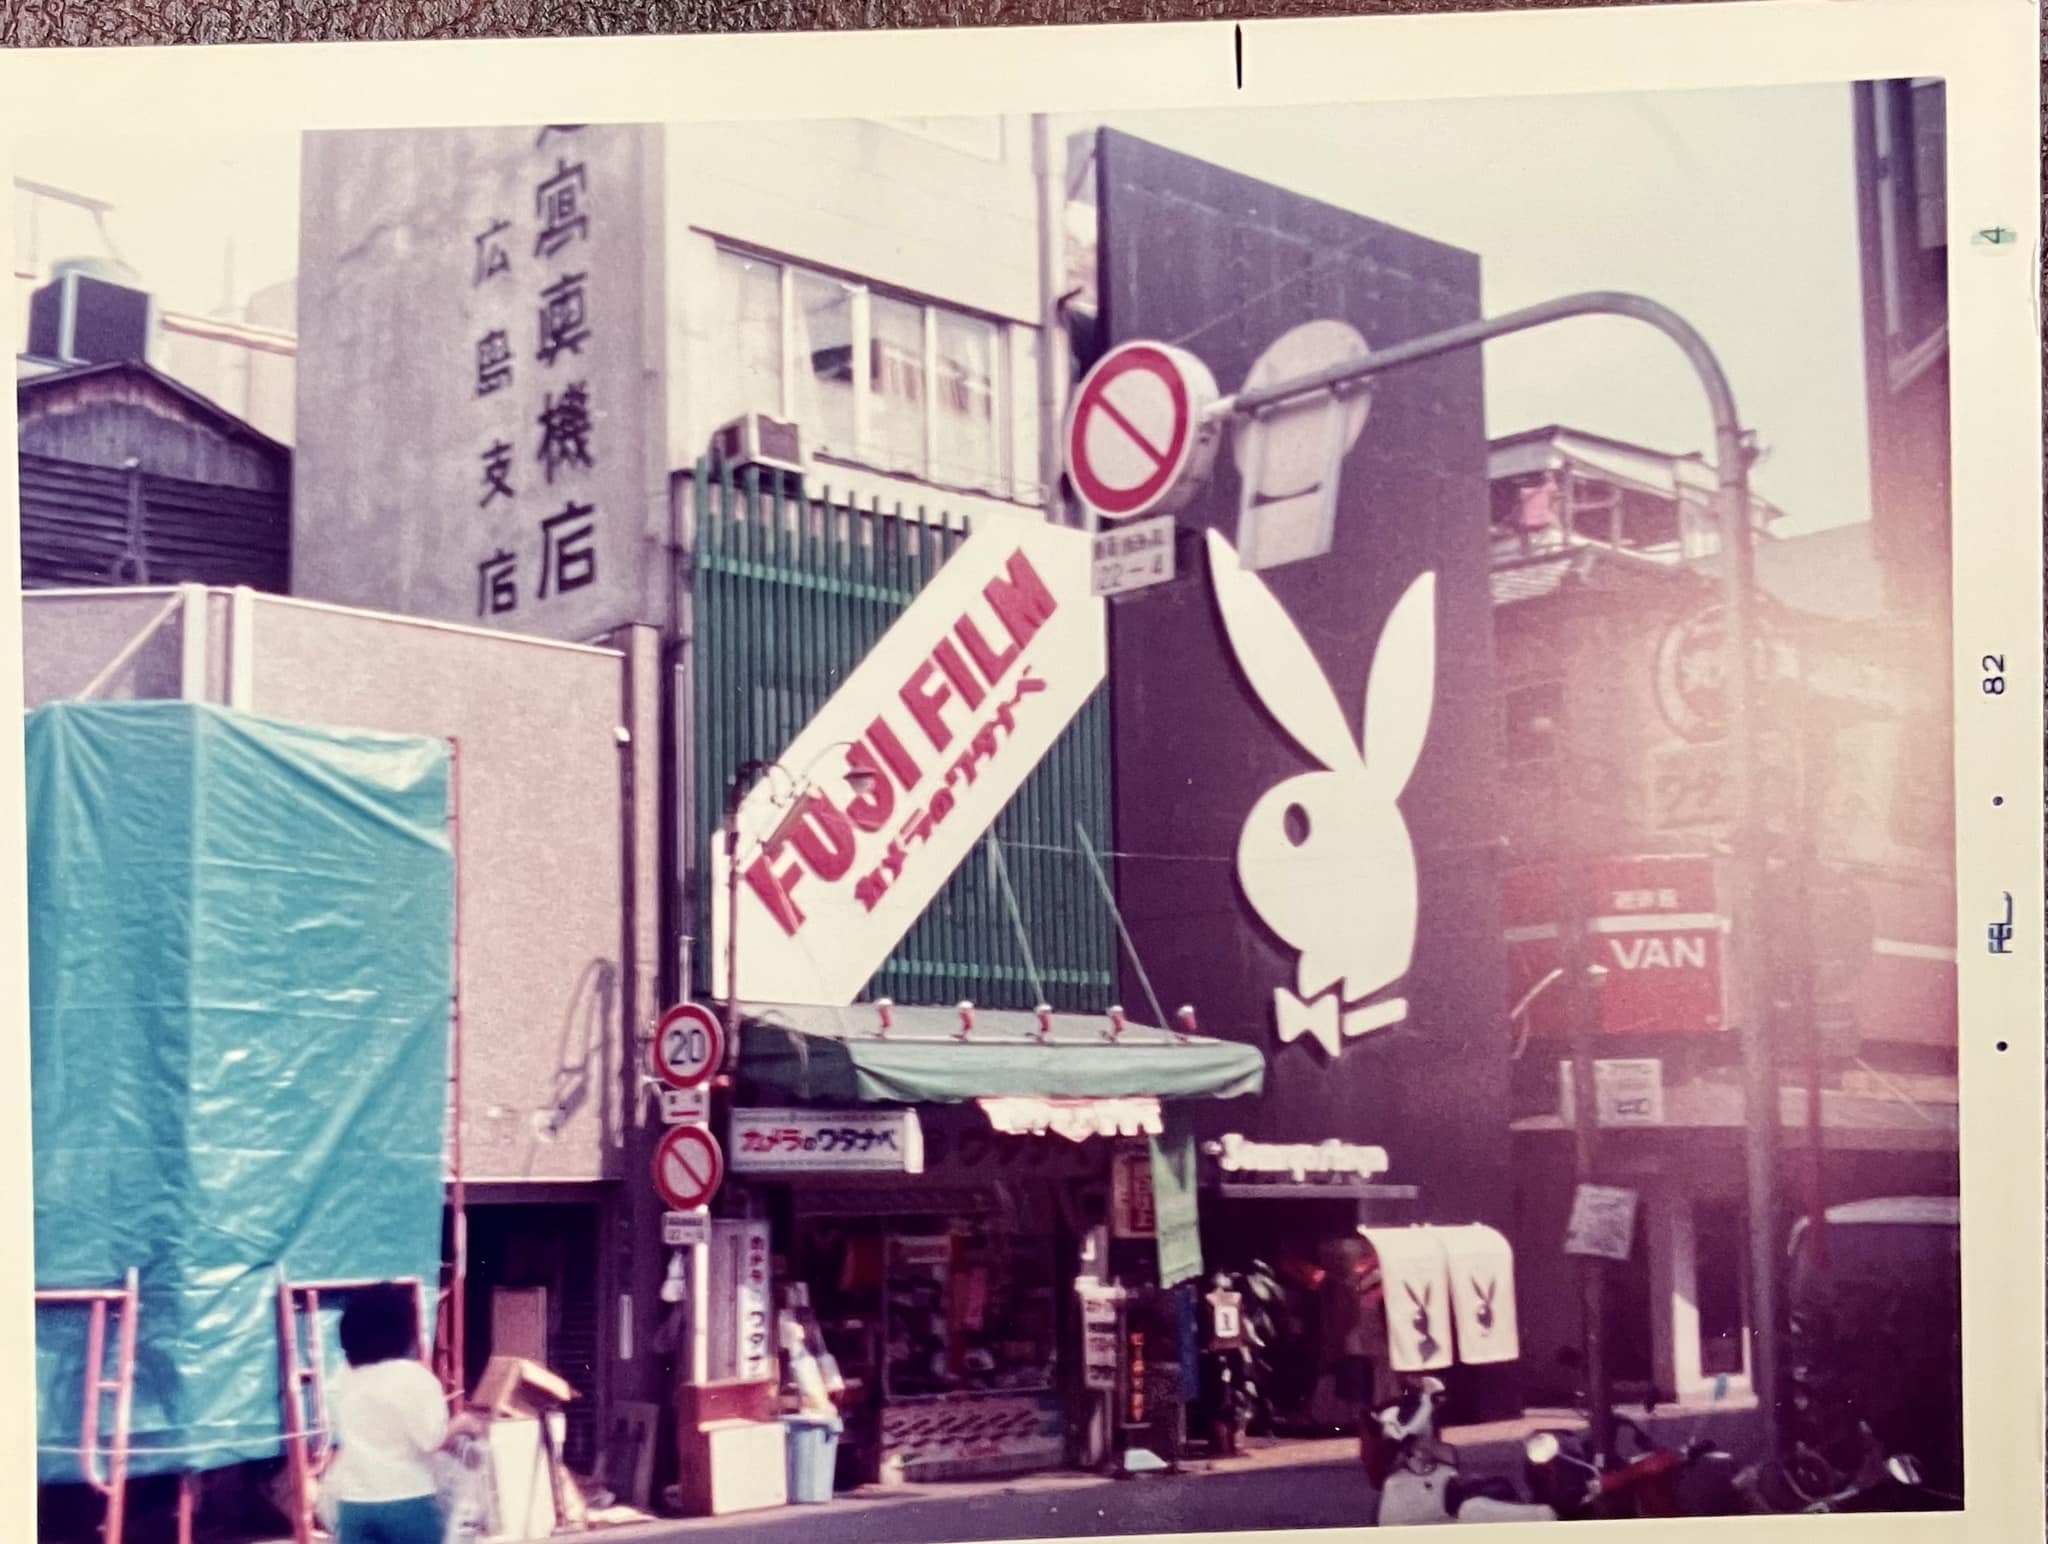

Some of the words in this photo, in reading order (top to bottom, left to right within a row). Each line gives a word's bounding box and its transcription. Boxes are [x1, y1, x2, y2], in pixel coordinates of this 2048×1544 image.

[473, 218, 518, 617] 広島支店
[744, 714, 924, 938] FUJI
[899, 546, 1059, 753] FILM
[669, 1029, 706, 1066] 20
[1608, 936, 1706, 970] VAN
